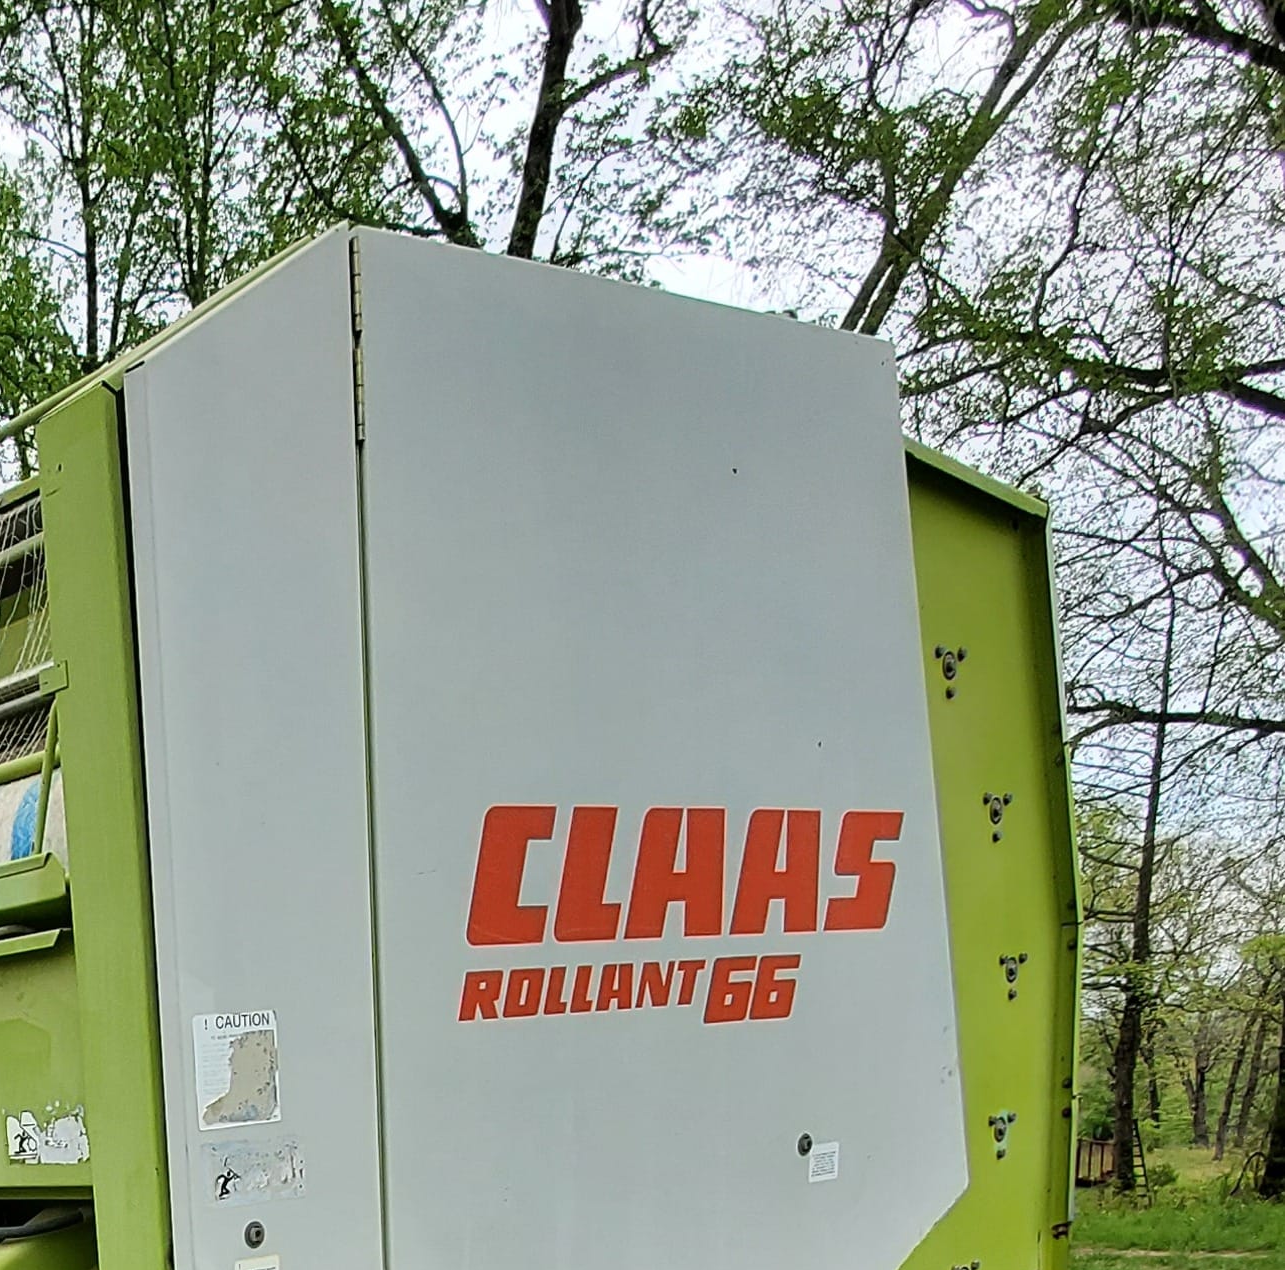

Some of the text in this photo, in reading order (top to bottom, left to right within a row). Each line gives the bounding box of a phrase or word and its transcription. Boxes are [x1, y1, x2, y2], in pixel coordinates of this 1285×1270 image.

[466, 805, 904, 945] CLAAS
[216, 1012, 269, 1029] CAUTION
[458, 954, 801, 1024] ROLLANT 66
